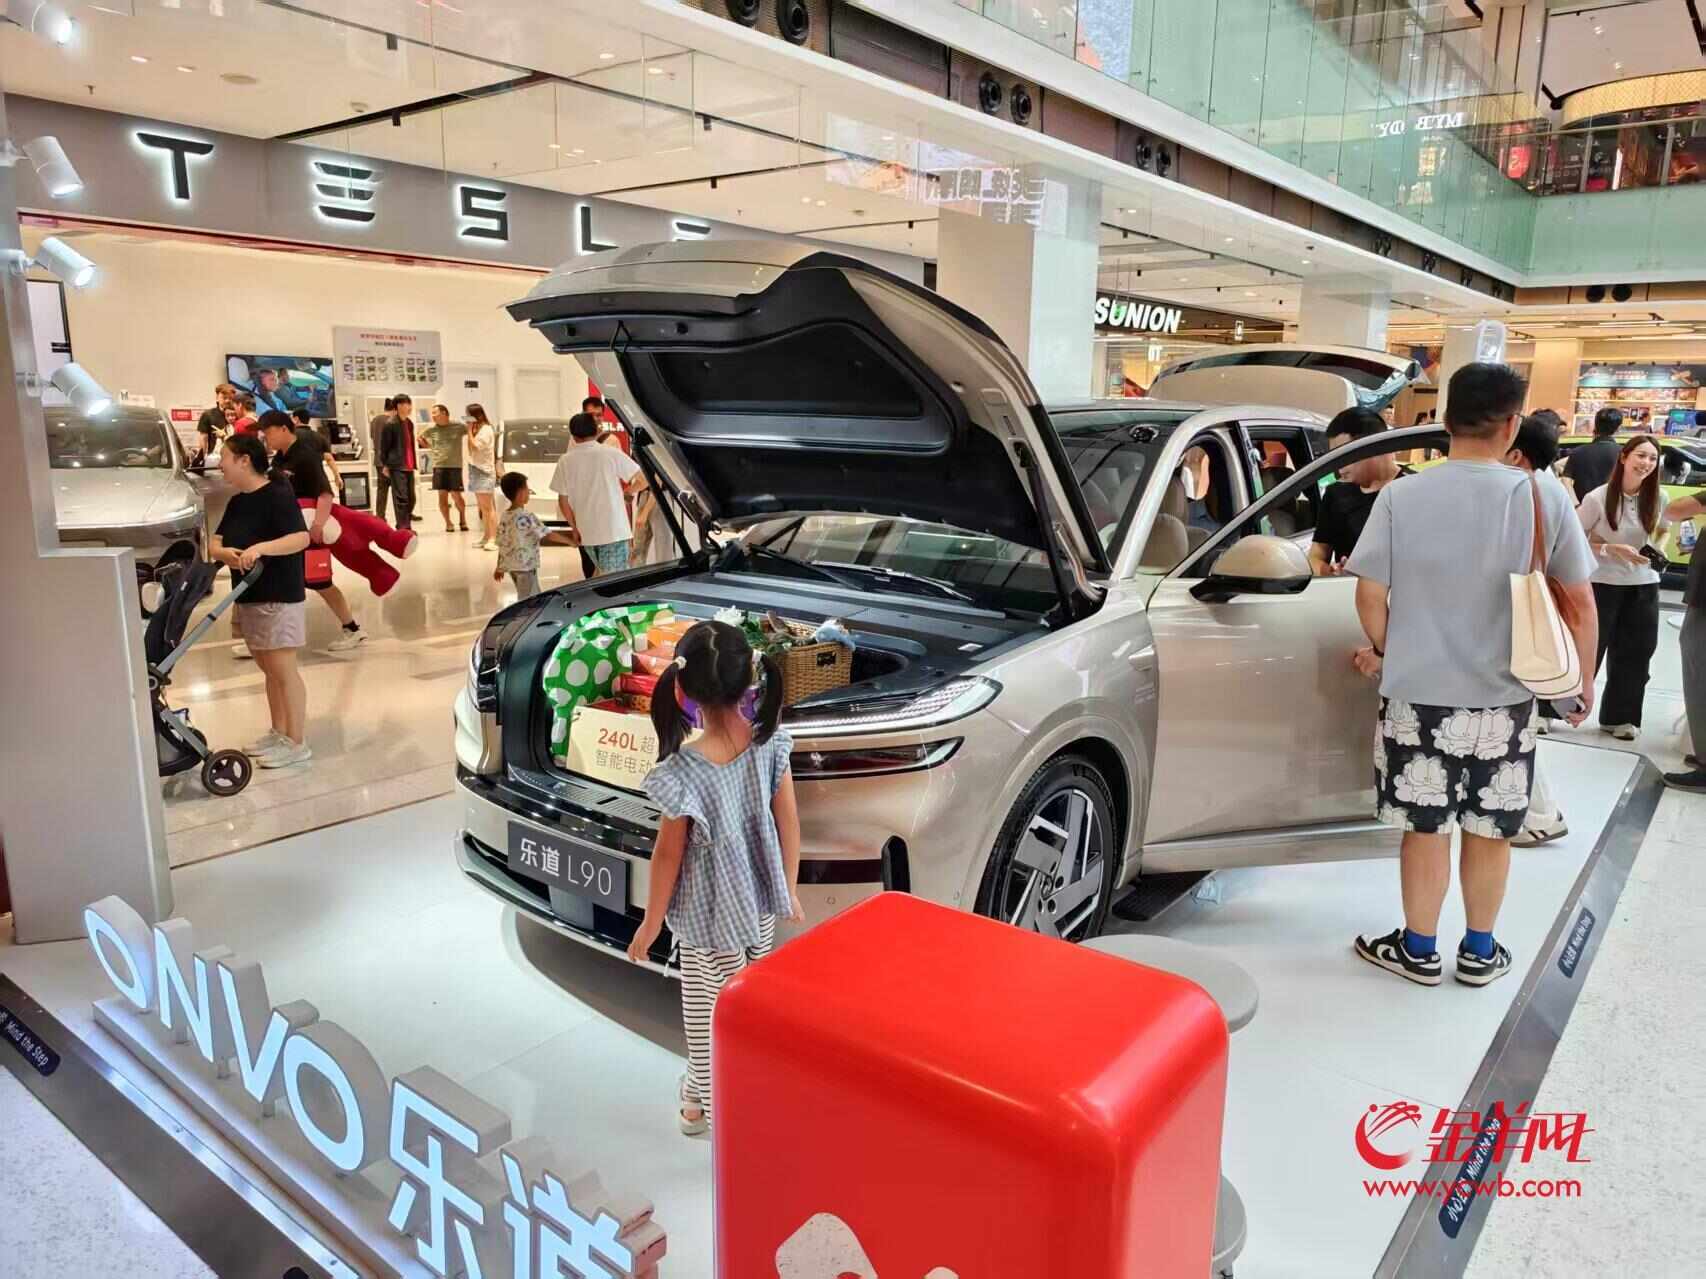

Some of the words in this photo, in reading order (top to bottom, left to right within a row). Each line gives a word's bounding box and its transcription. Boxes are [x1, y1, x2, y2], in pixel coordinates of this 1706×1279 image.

[1094, 297, 1182, 334] SUNION
[598, 727, 638, 752] 240L
[520, 837, 561, 878] 乐道
[567, 854, 613, 896] L90
[20, 1035, 35, 1053] the
[31, 1046, 49, 1067] Step
[84, 900, 366, 1173] ONVO
[1466, 1150, 1484, 1180] Mind
